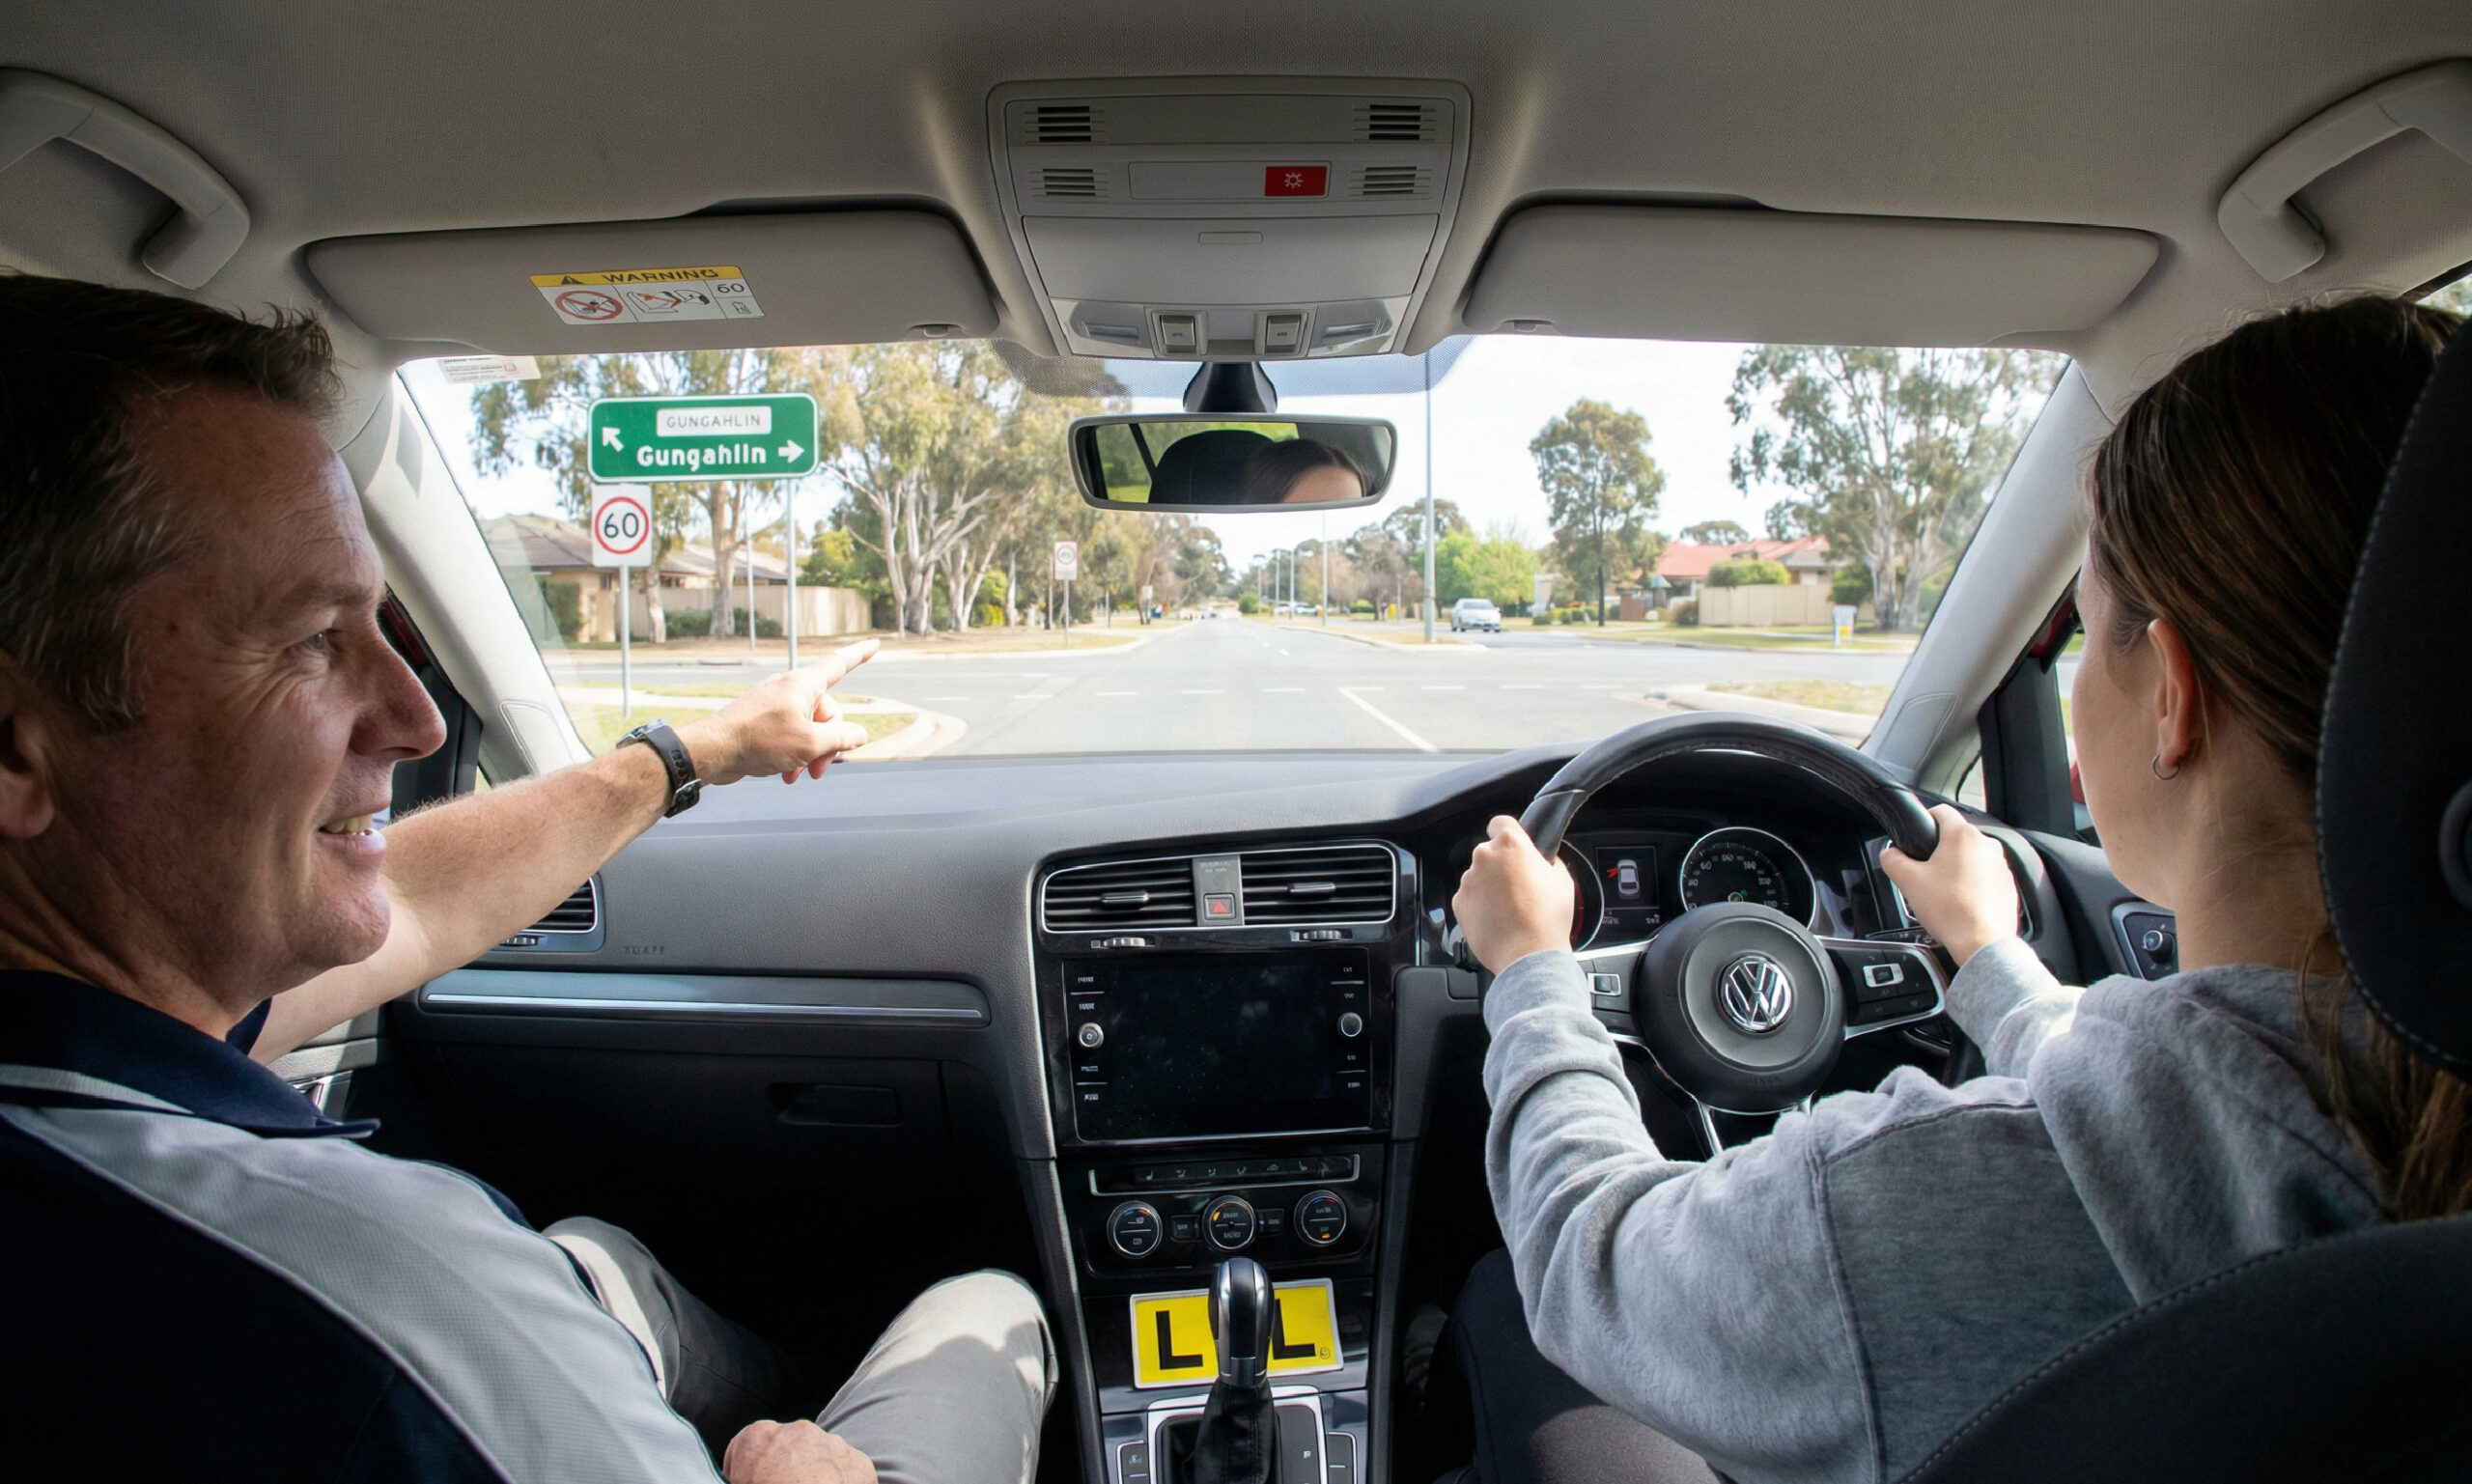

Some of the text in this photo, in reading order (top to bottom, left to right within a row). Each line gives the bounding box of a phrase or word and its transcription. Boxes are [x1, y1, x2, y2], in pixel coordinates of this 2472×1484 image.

[602, 269, 718, 283] WARNING
[717, 283, 744, 294] 60
[666, 414, 761, 428] GUNGAHLIN
[637, 443, 766, 471] Gungahlin
[604, 513, 639, 538] 60
[1156, 1310, 1203, 1369] L
[1272, 1299, 1316, 1359] L
